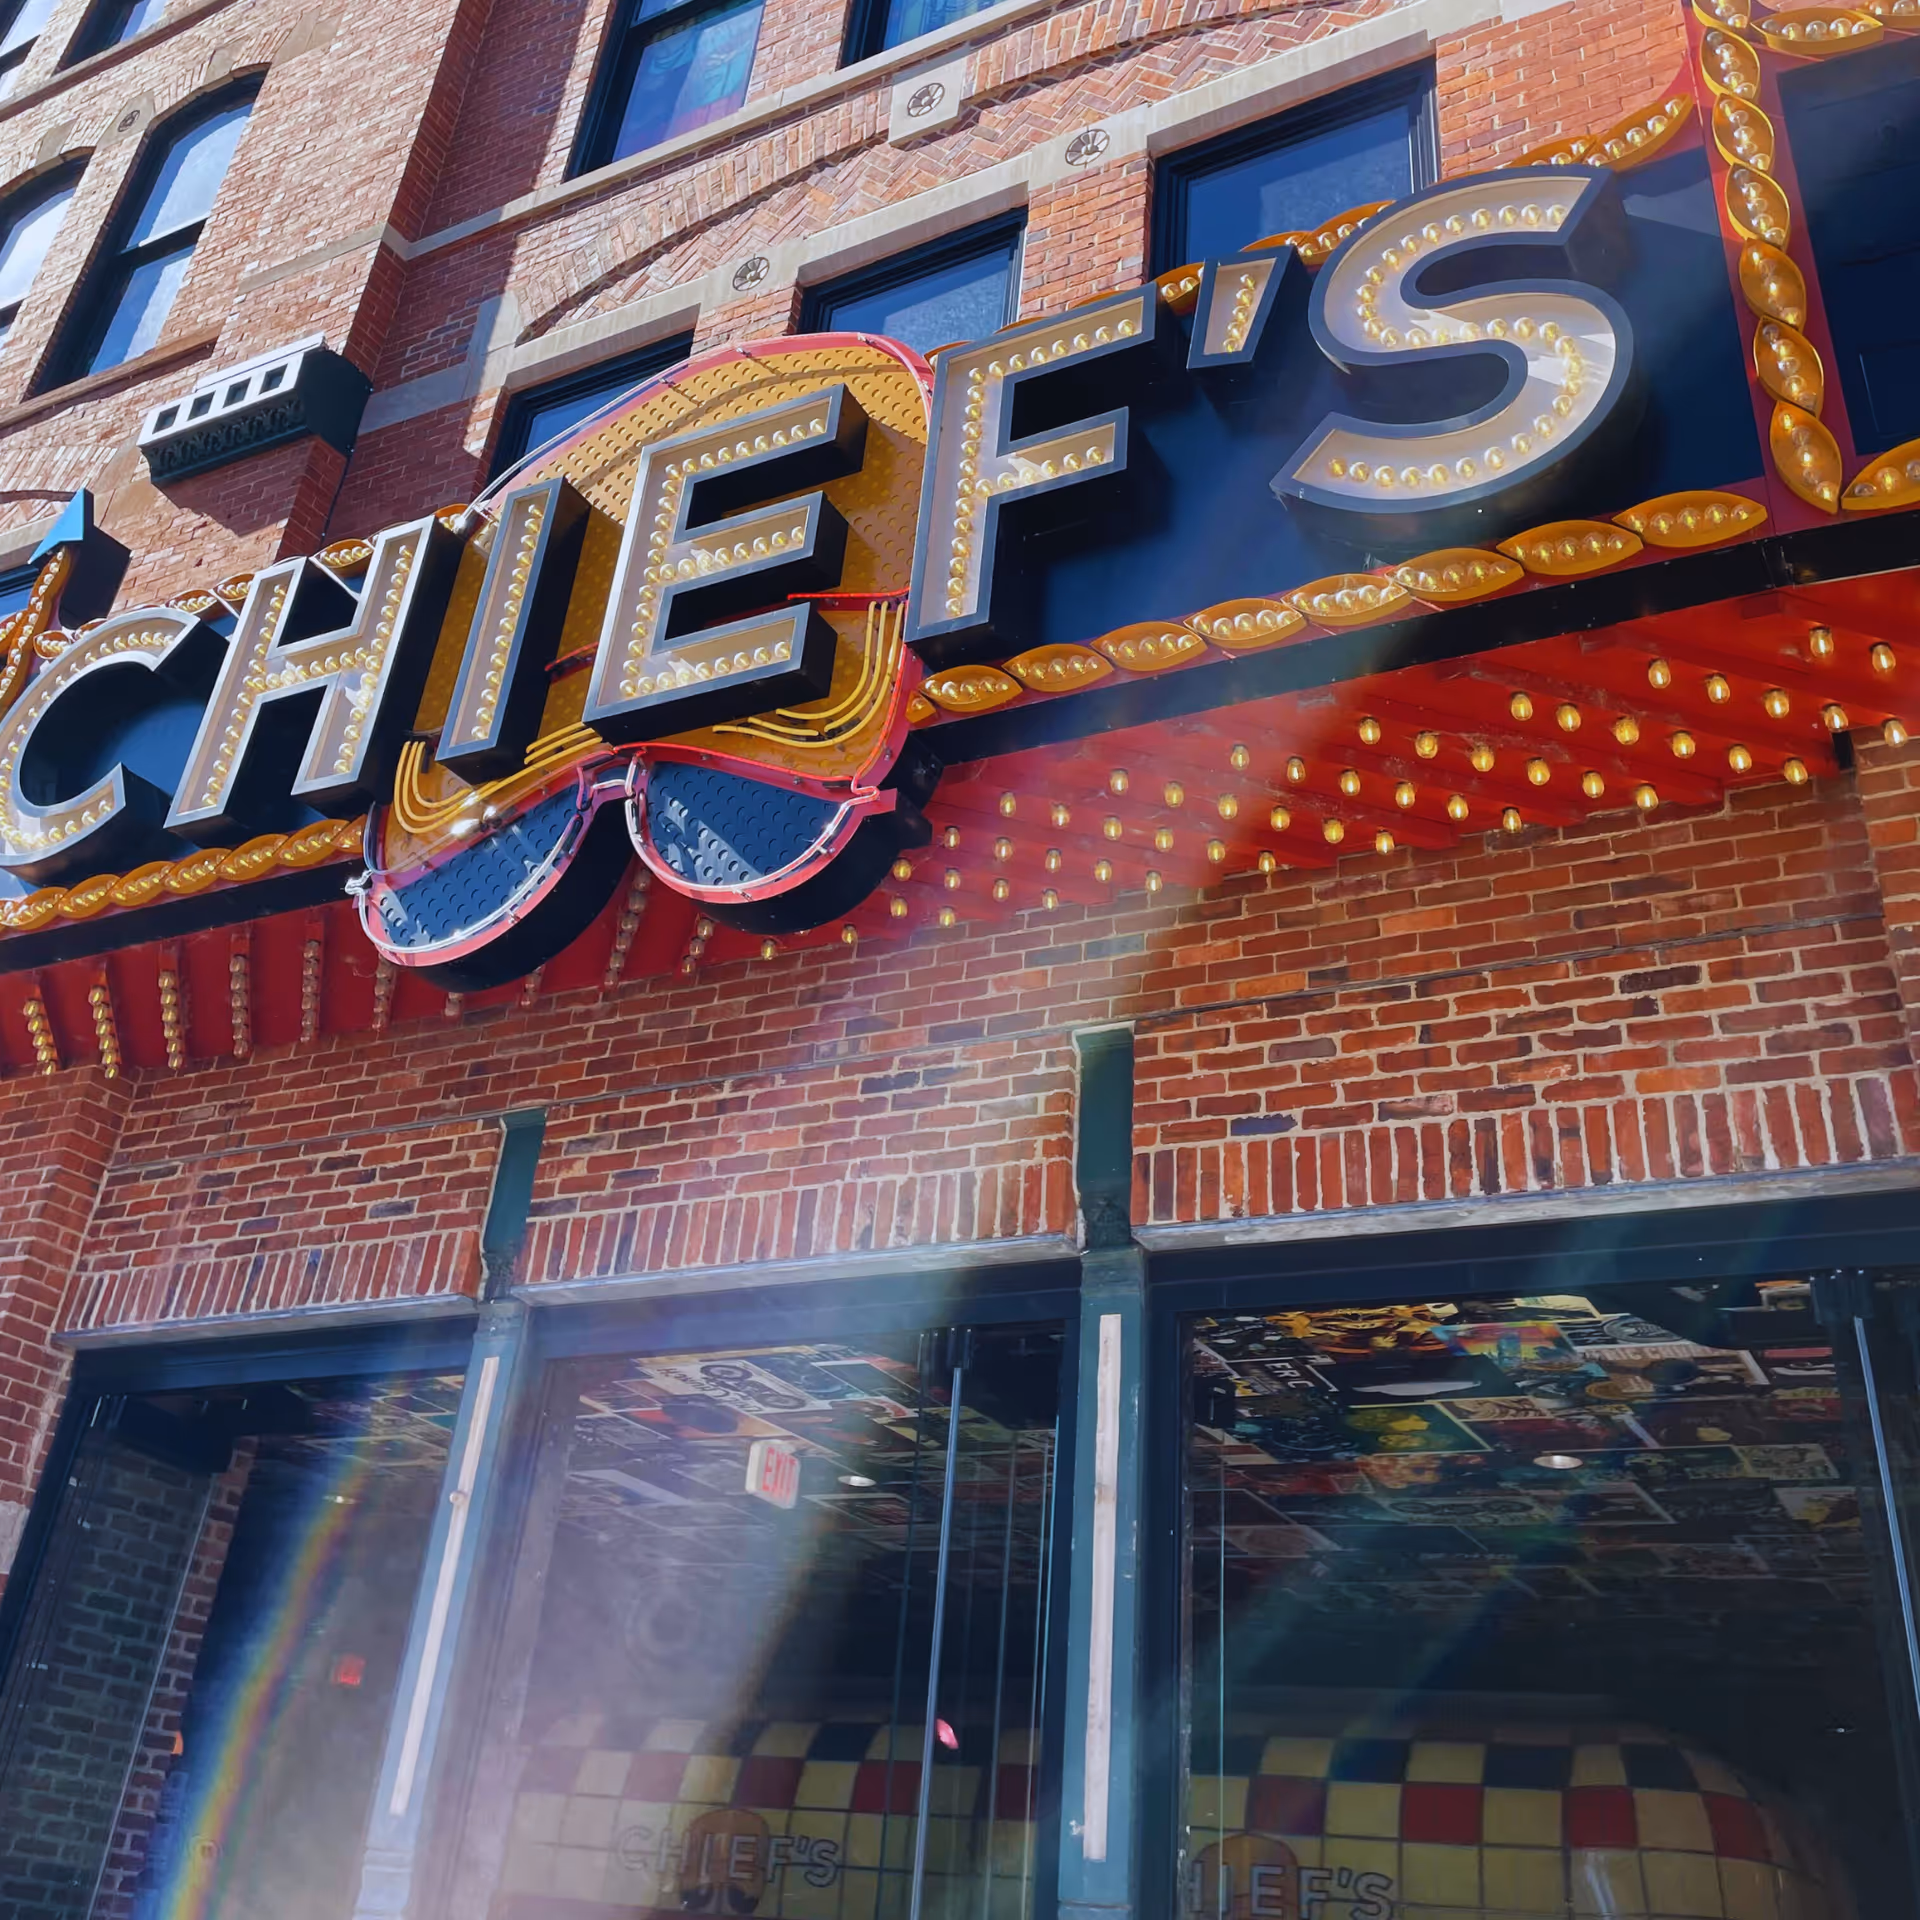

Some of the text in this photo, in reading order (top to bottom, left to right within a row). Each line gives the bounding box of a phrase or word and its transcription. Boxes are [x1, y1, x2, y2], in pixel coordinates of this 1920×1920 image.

[0, 163, 1634, 868] CHIEF'S
[762, 1447, 797, 1503] EXIT
[618, 1825, 840, 1888] CHIEF'S
